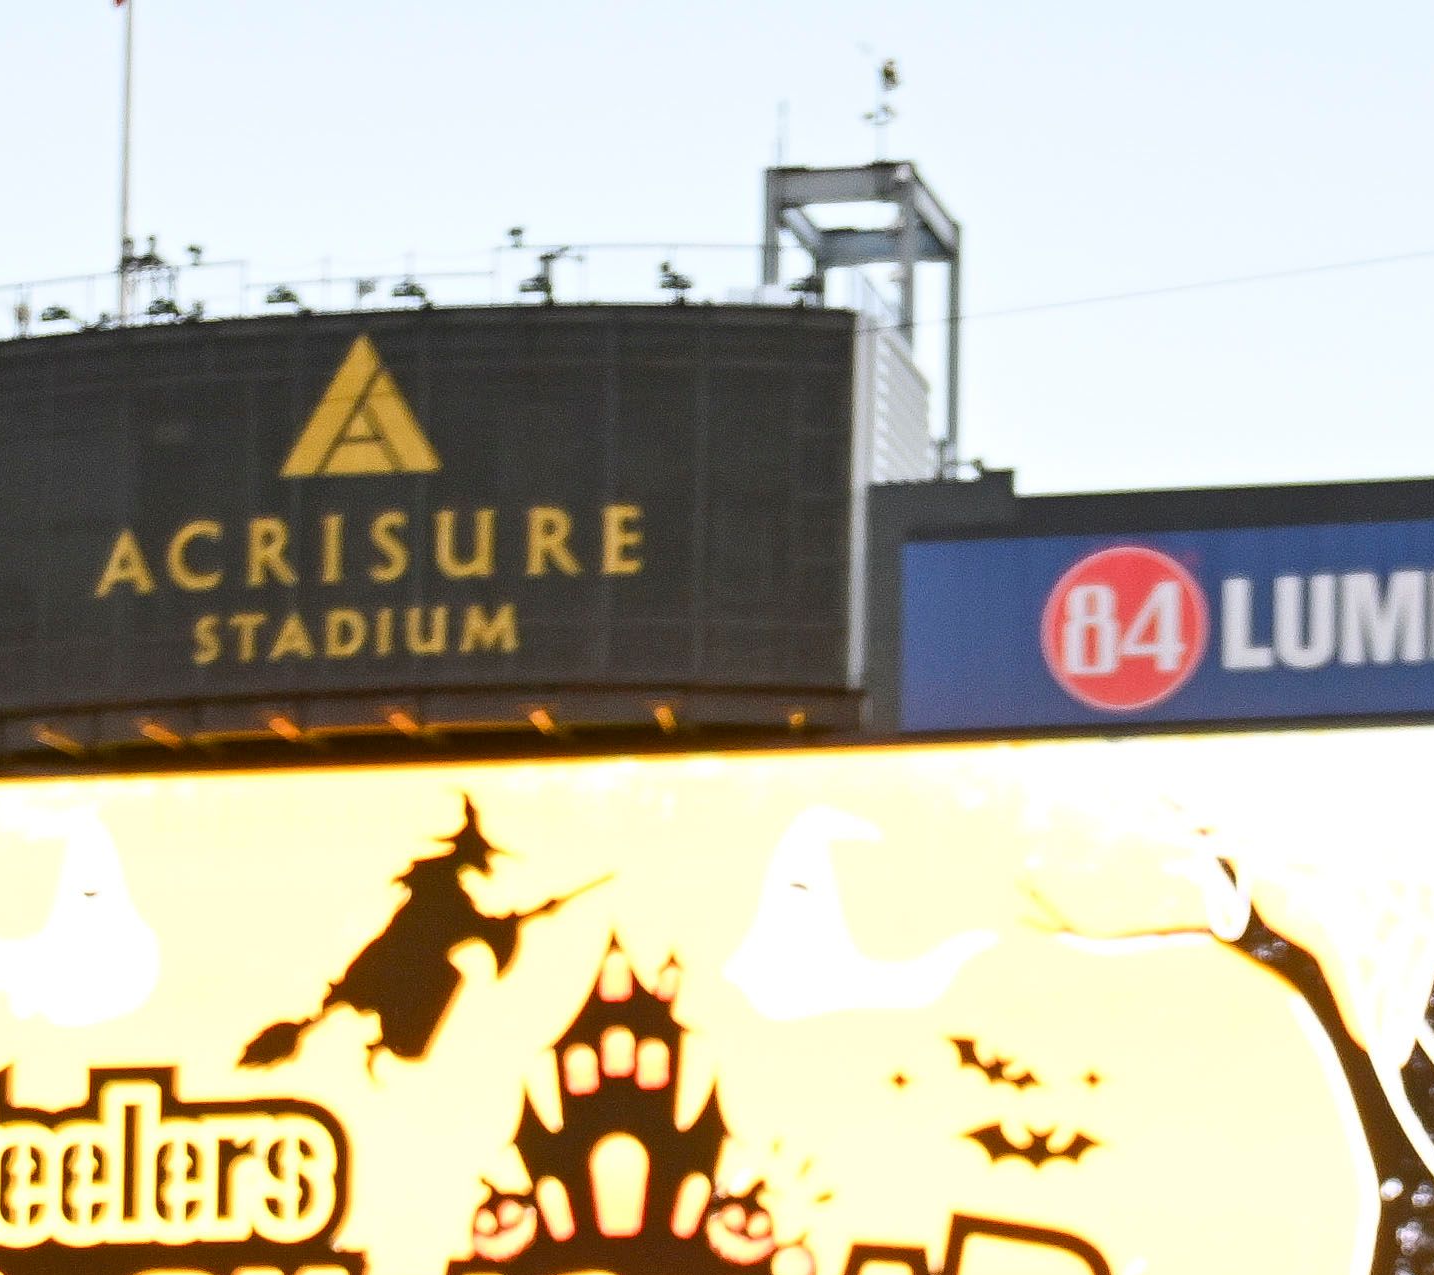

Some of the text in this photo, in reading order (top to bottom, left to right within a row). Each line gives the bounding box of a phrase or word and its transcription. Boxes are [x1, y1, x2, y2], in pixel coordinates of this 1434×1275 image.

[94, 504, 647, 597] ACRISURE
[193, 604, 520, 665] STADIUM
[1059, 579, 1188, 677] 84
